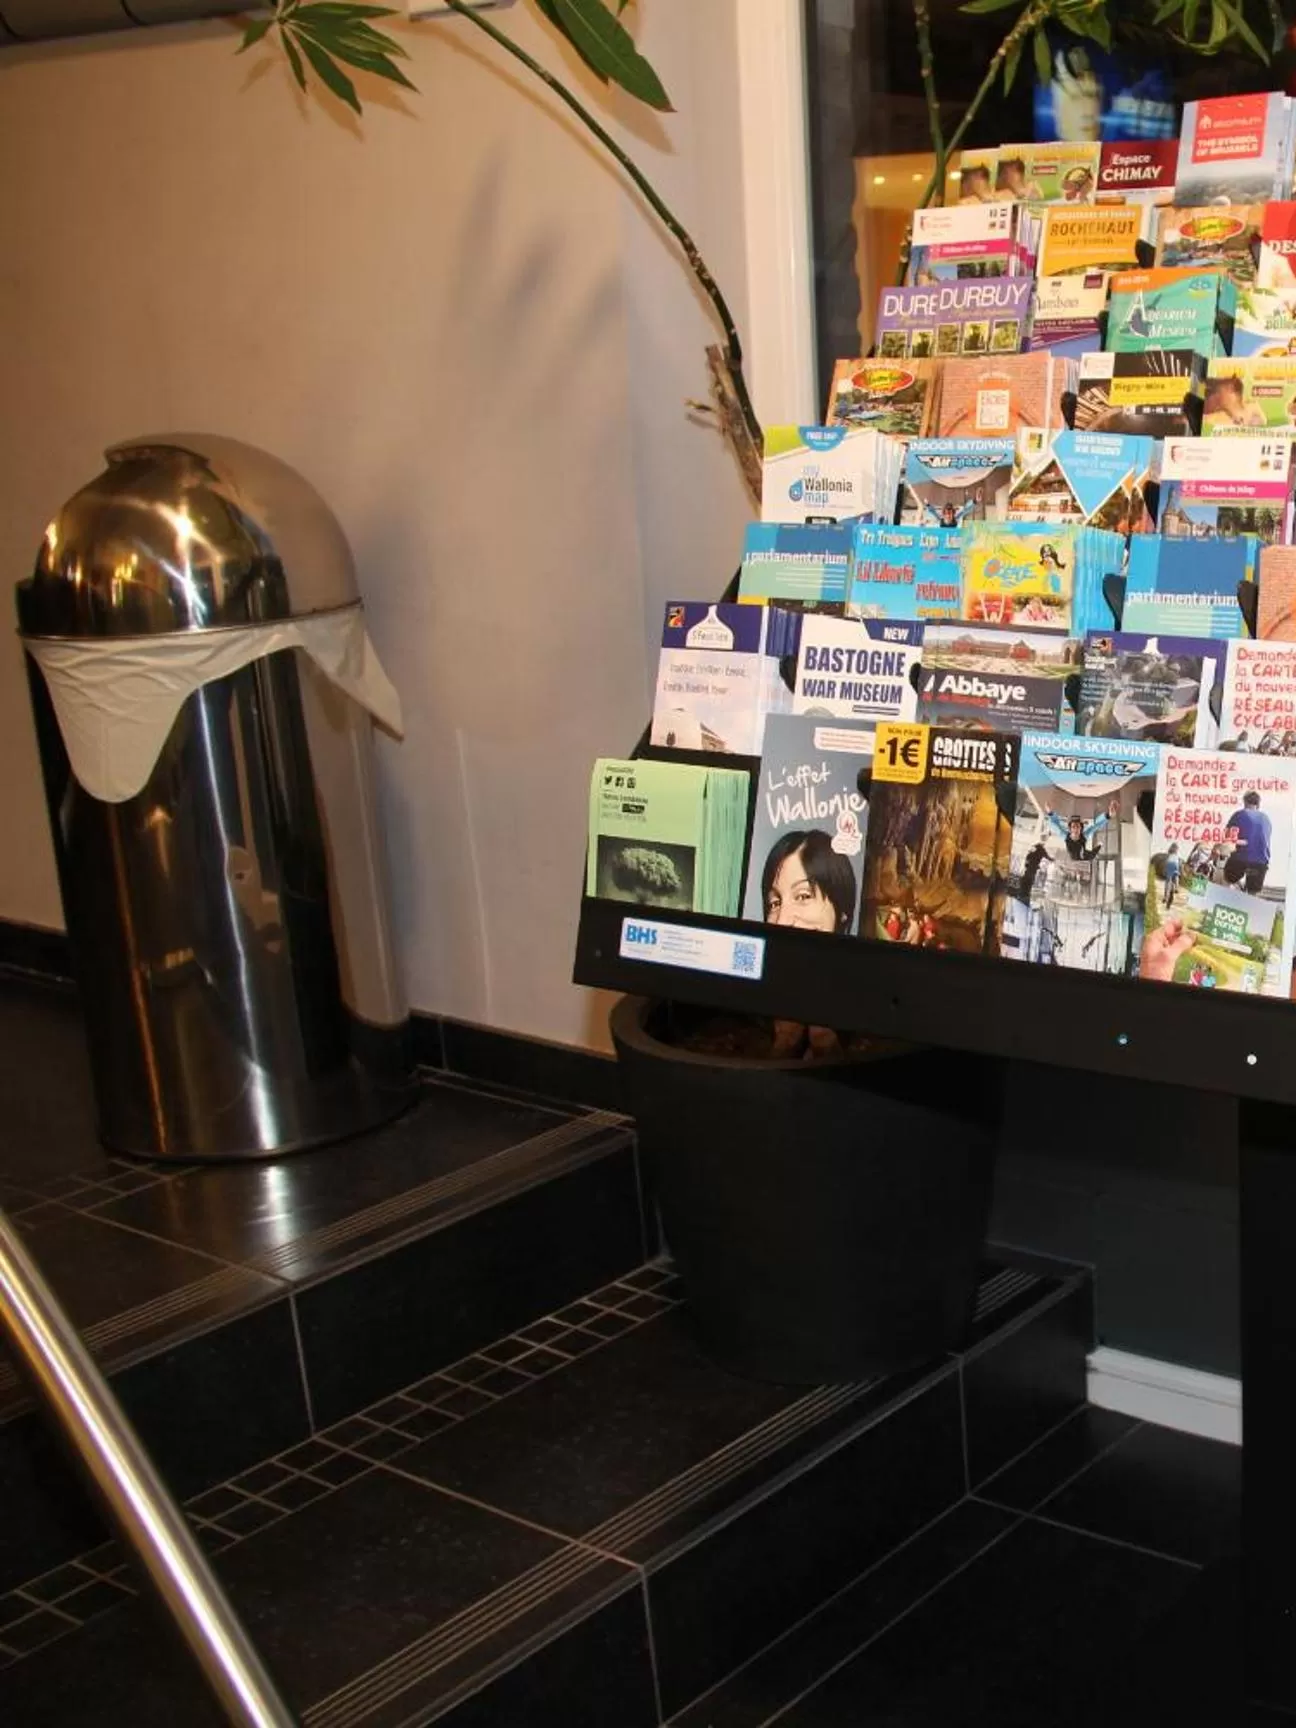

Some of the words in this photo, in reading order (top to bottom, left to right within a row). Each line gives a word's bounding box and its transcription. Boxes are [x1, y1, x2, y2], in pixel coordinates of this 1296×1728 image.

[1112, 153, 1152, 167] Espace
[1101, 165, 1163, 182] CHIMAY
[939, 282, 1028, 311] DURBUY
[909, 440, 956, 453] INDOOR
[957, 439, 1015, 452] SKYDIVING
[803, 476, 854, 493] Wallonia
[802, 491, 830, 506] map
[749, 547, 848, 566] parlamentarium
[1125, 587, 1239, 608] parlamentarium
[883, 626, 910, 641] NEW
[803, 646, 905, 678] BASTOGNE
[1235, 663, 1249, 677] la
[801, 678, 837, 700] WAR
[839, 680, 903, 705] MUSEUM
[938, 674, 1027, 703] Abbaye
[1235, 679, 1251, 693] du
[1233, 694, 1294, 714] RÉSEAU
[879, 736, 921, 768] -1€
[932, 735, 997, 770] GROTTES
[1026, 735, 1081, 753] INDOOR
[1083, 738, 1156, 760] SKYDIVING
[1166, 753, 1237, 773] Demandez
[767, 765, 832, 792] L'effet
[1164, 772, 1178, 787] la
[1180, 772, 1228, 790] CARTE
[1230, 776, 1290, 793] gratuite
[1164, 789, 1181, 803] du
[1183, 792, 1239, 806] nouveau
[765, 787, 869, 829] Wallonie
[1163, 805, 1223, 826] RÉSEAU
[1215, 907, 1245, 925] 1000
[626, 924, 658, 945] BHS
